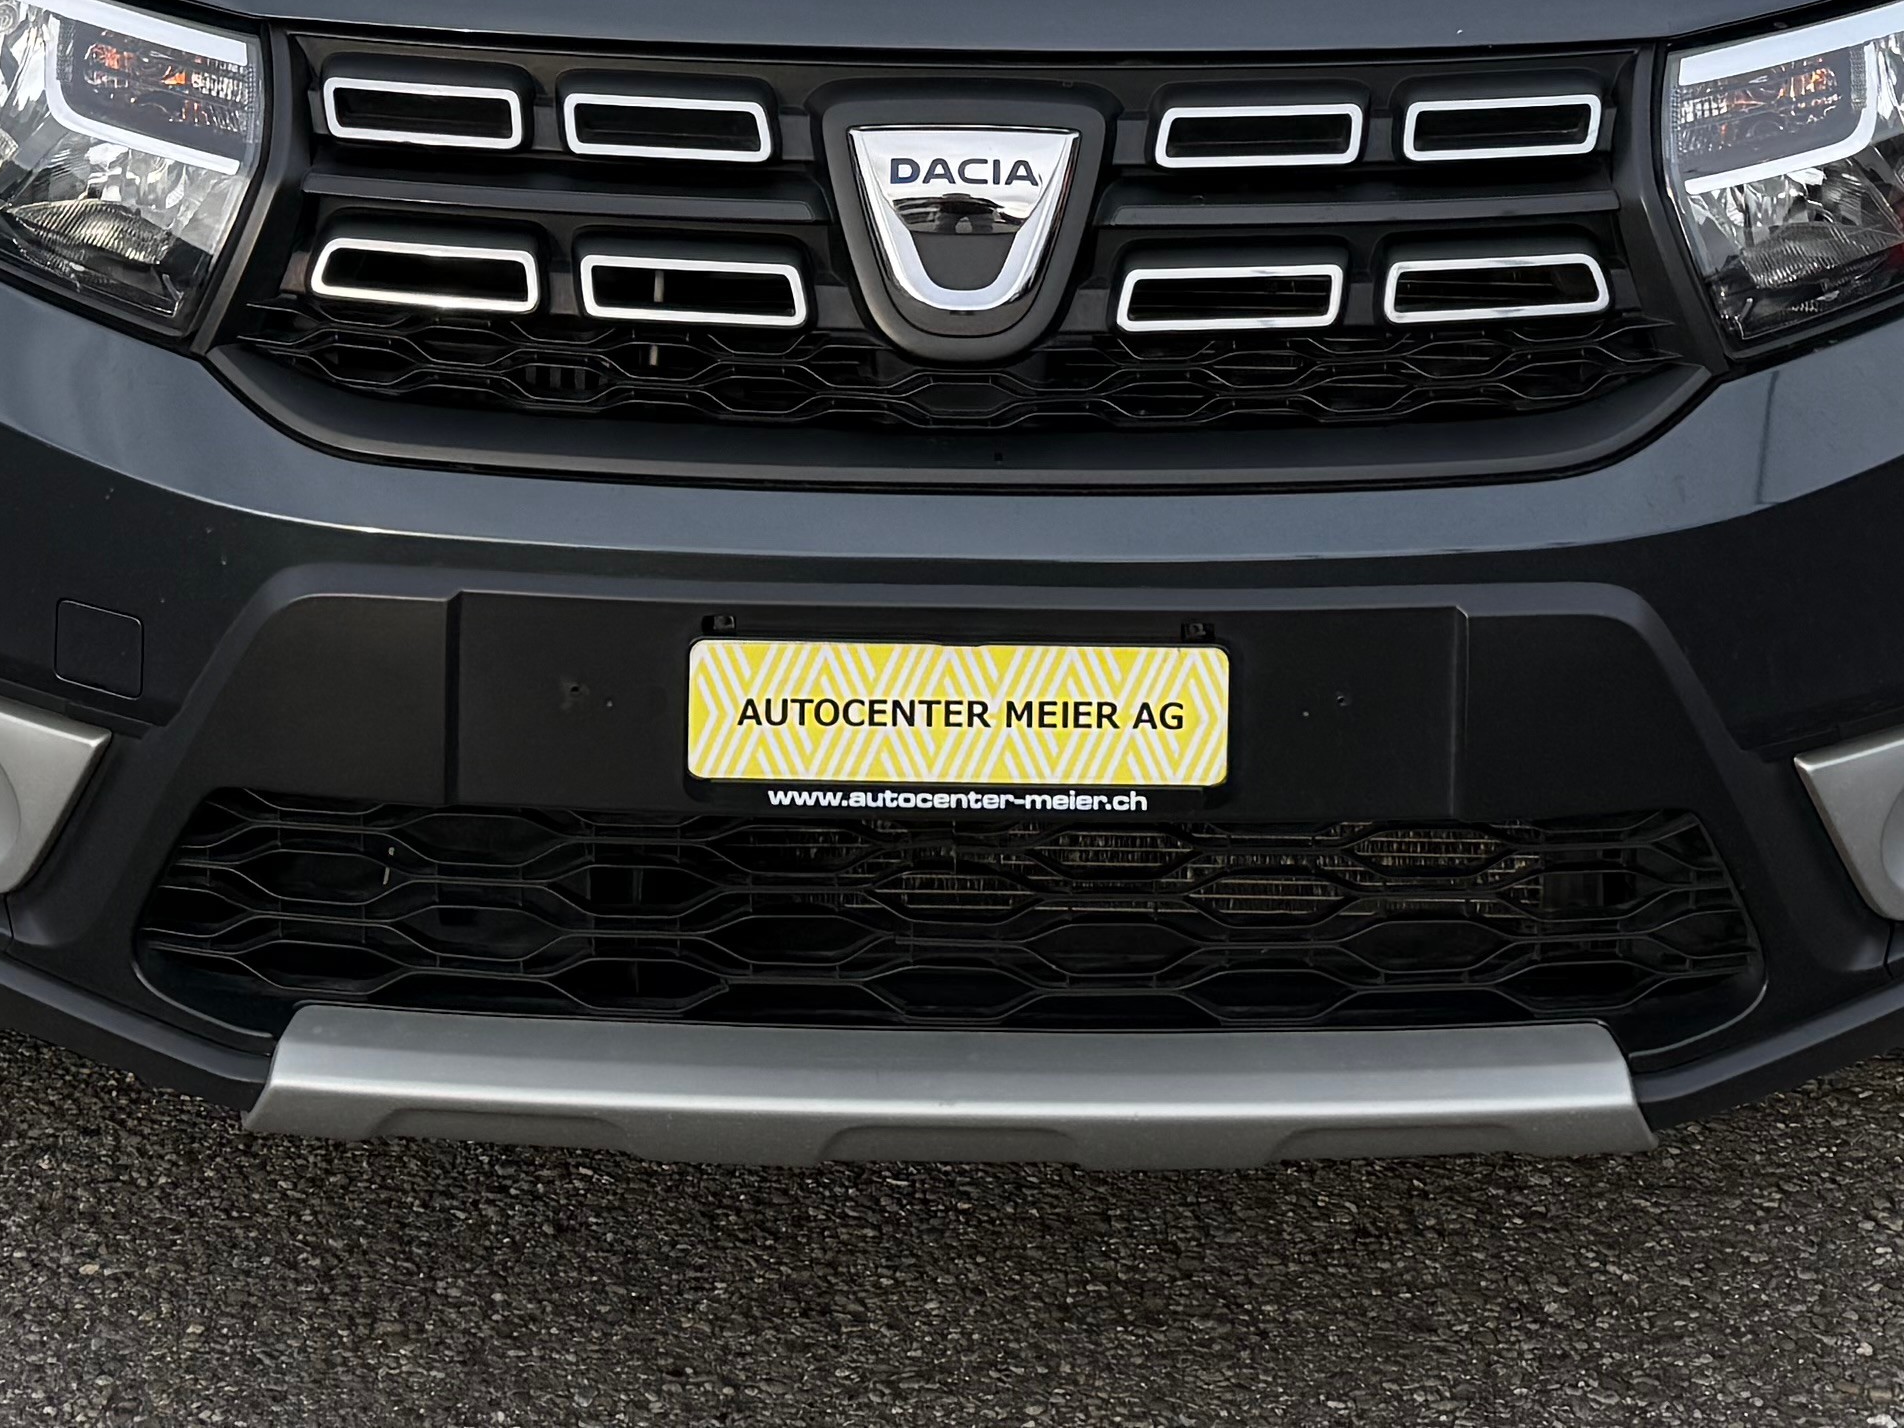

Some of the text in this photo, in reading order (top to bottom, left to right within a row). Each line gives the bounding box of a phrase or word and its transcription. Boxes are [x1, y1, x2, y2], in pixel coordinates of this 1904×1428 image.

[889, 158, 1040, 187] DACIA
[736, 697, 1186, 731] AUTOCENTER MEIER AG
[767, 787, 1148, 812] www.autocenter-meier.ch
